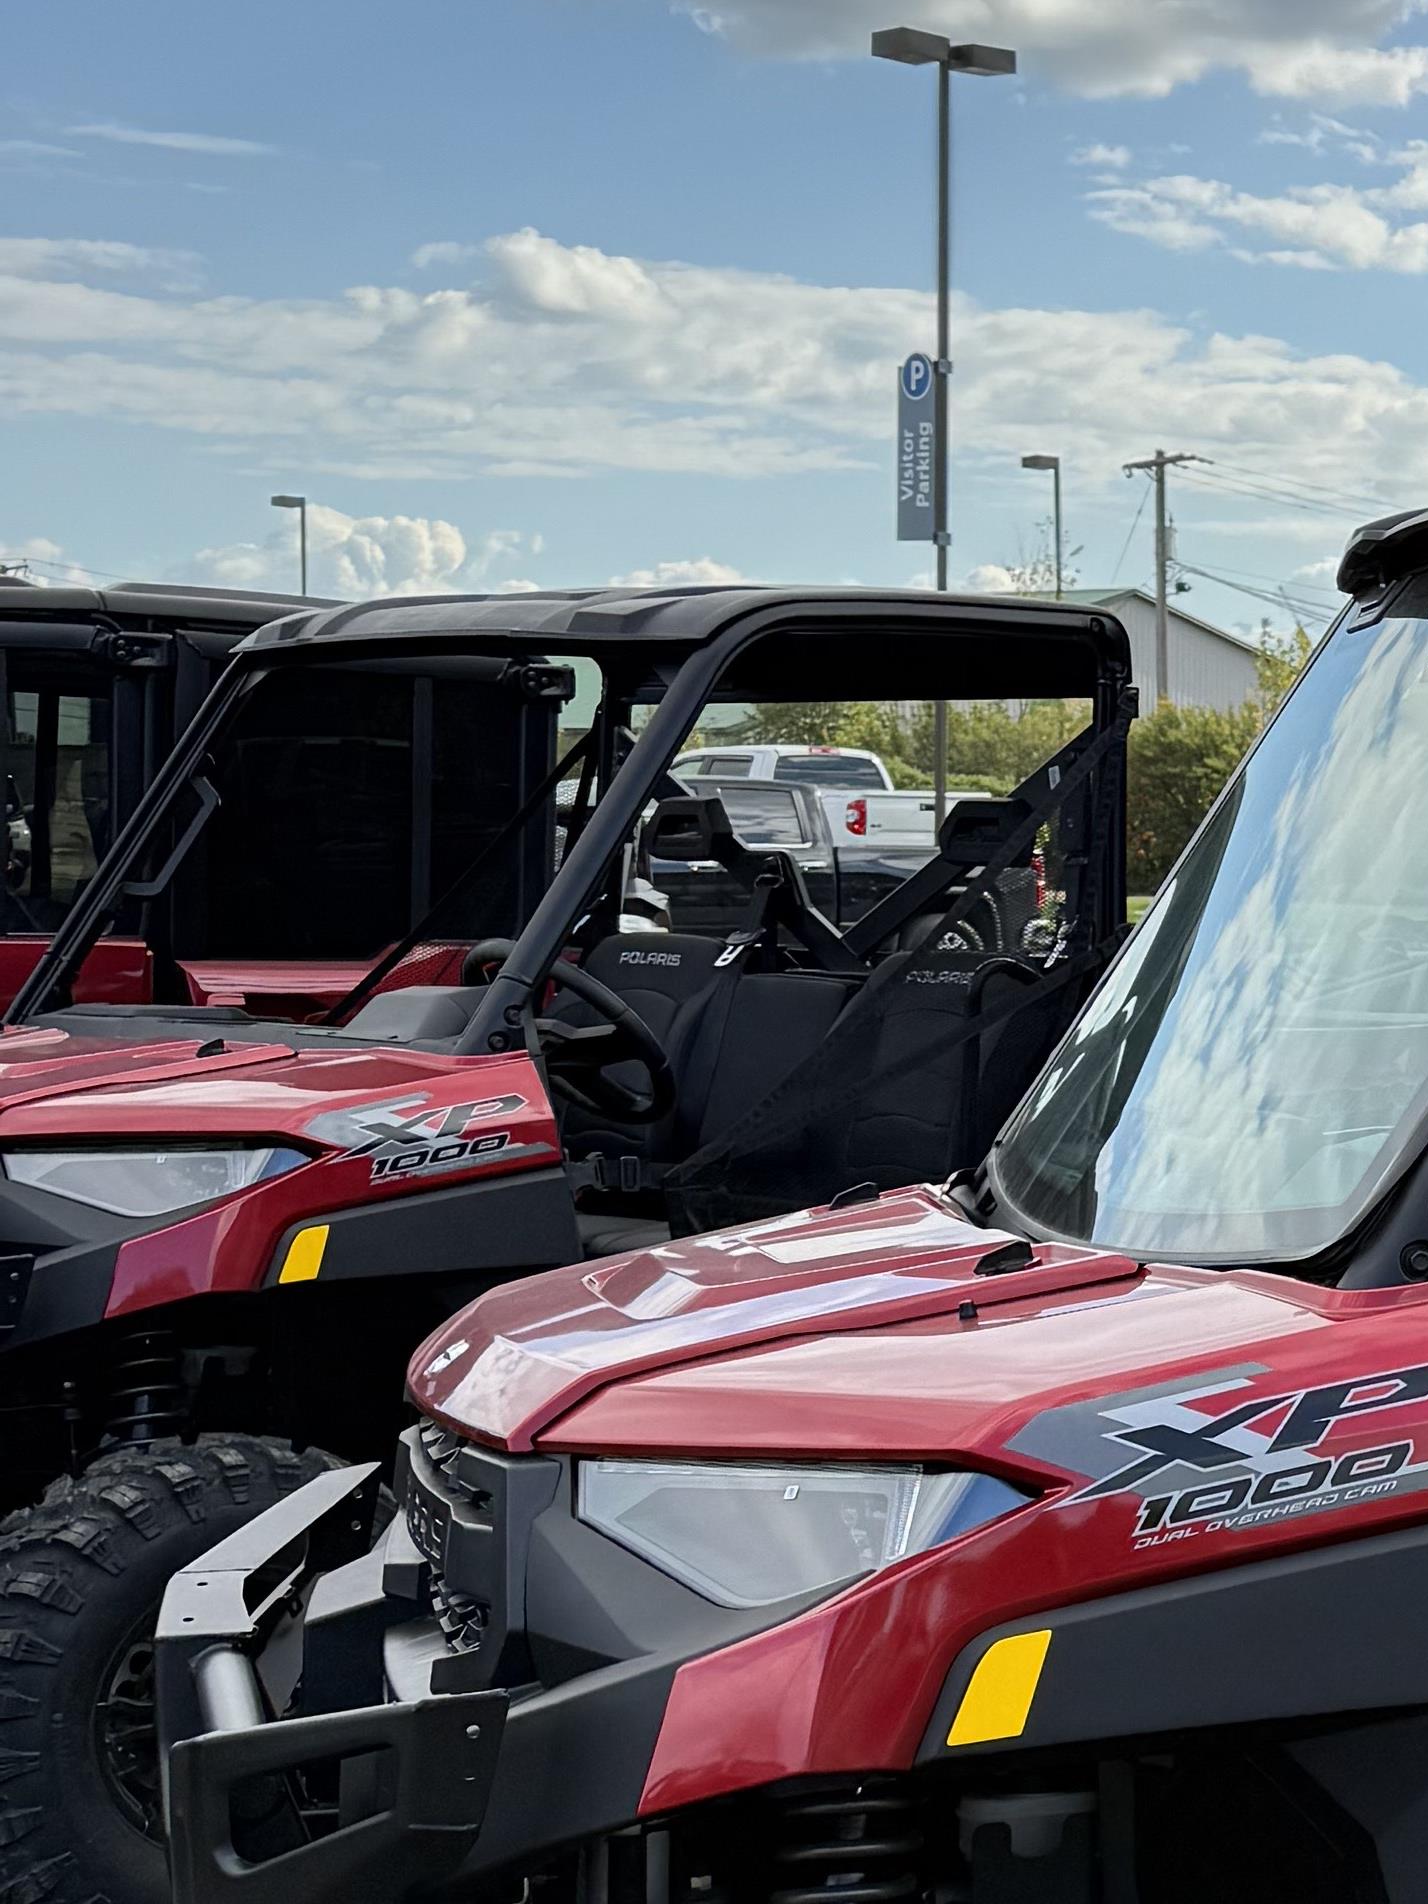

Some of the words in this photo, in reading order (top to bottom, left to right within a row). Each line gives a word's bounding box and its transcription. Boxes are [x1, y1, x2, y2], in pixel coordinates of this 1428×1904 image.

[901, 428, 914, 501] Visitor
[916, 421, 933, 507] Parking
[619, 951, 682, 967] POLARIS
[326, 1092, 529, 1165] XP
[369, 1131, 511, 1179] 1000
[1131, 1439, 1414, 1537] 1000
[1134, 1528, 1199, 1550] DUAL
[1205, 1493, 1338, 1533] OVERHEAD
[1343, 1480, 1398, 1500] CAM
